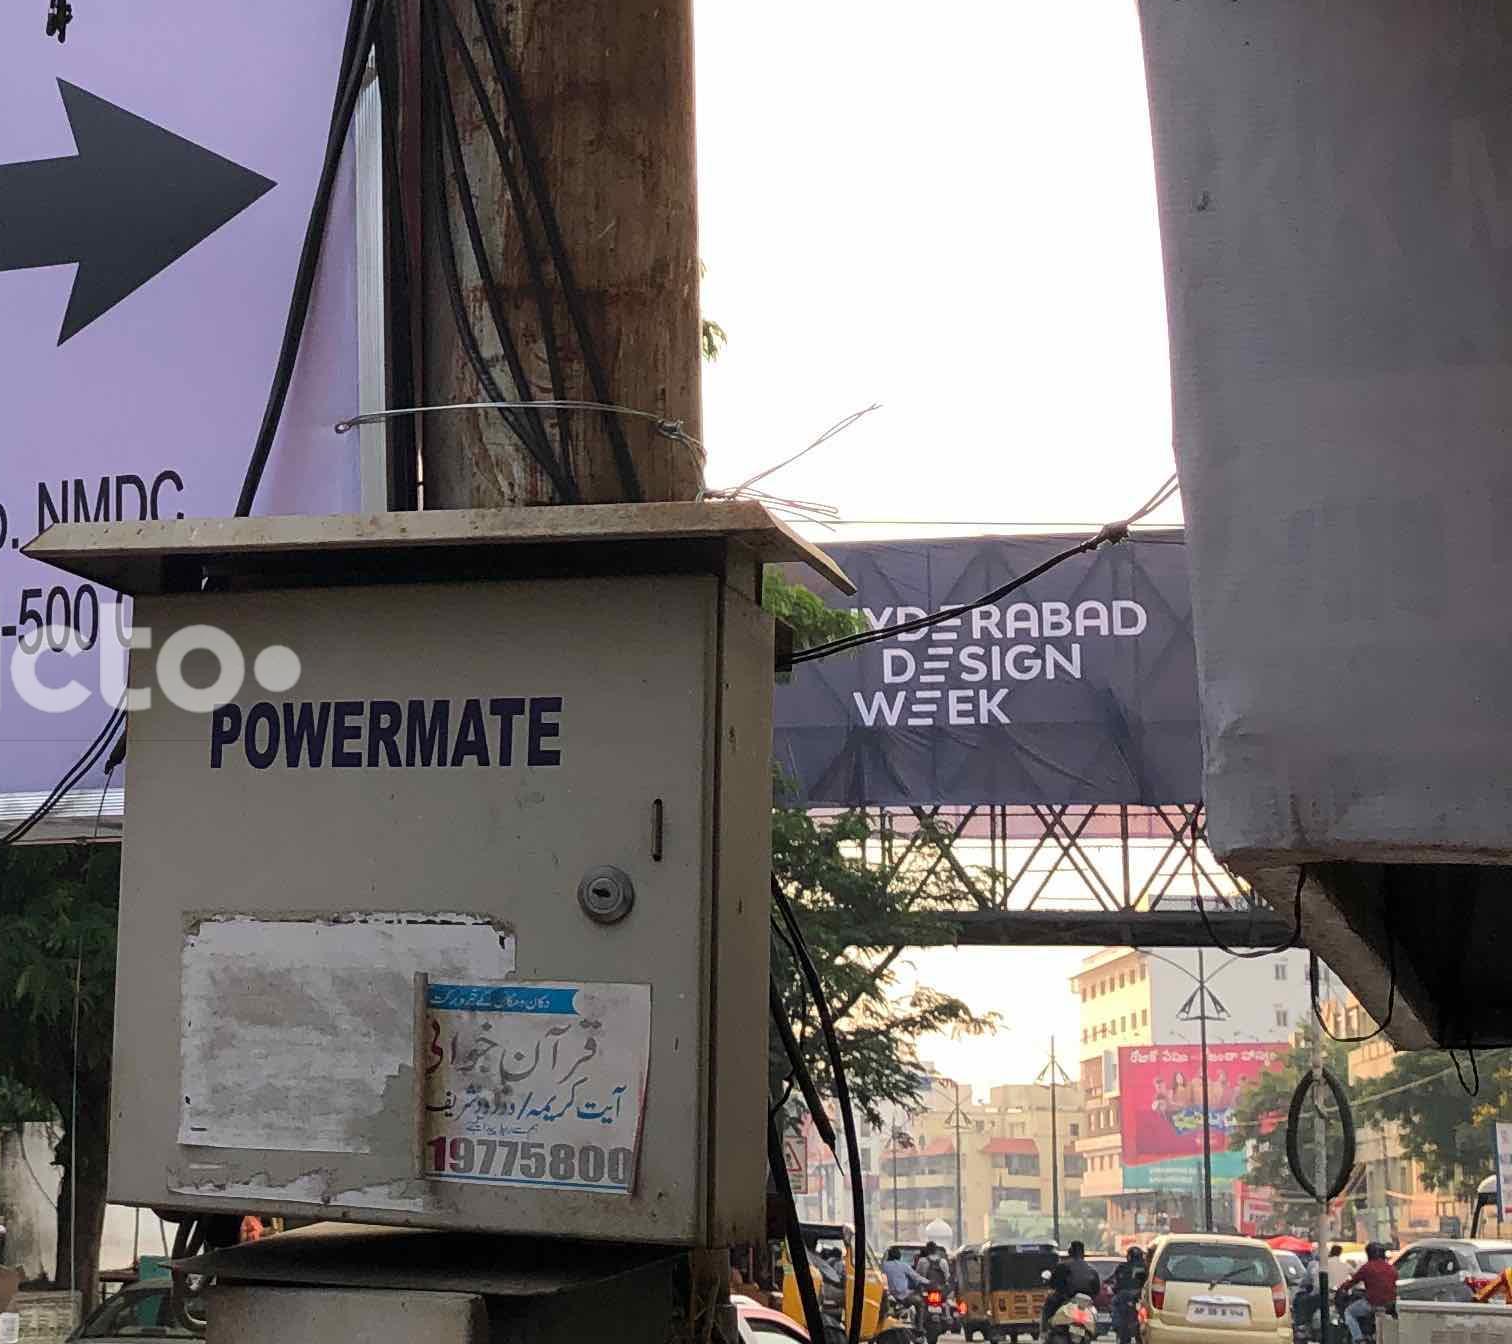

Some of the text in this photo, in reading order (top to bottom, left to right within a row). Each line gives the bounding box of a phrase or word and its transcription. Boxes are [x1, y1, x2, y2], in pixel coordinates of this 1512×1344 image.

[850, 599, 1148, 644] YDERABAD
[883, 642, 1082, 684] DESIGN
[852, 688, 1011, 727] WEEK
[209, 696, 564, 770] POWERMATE
